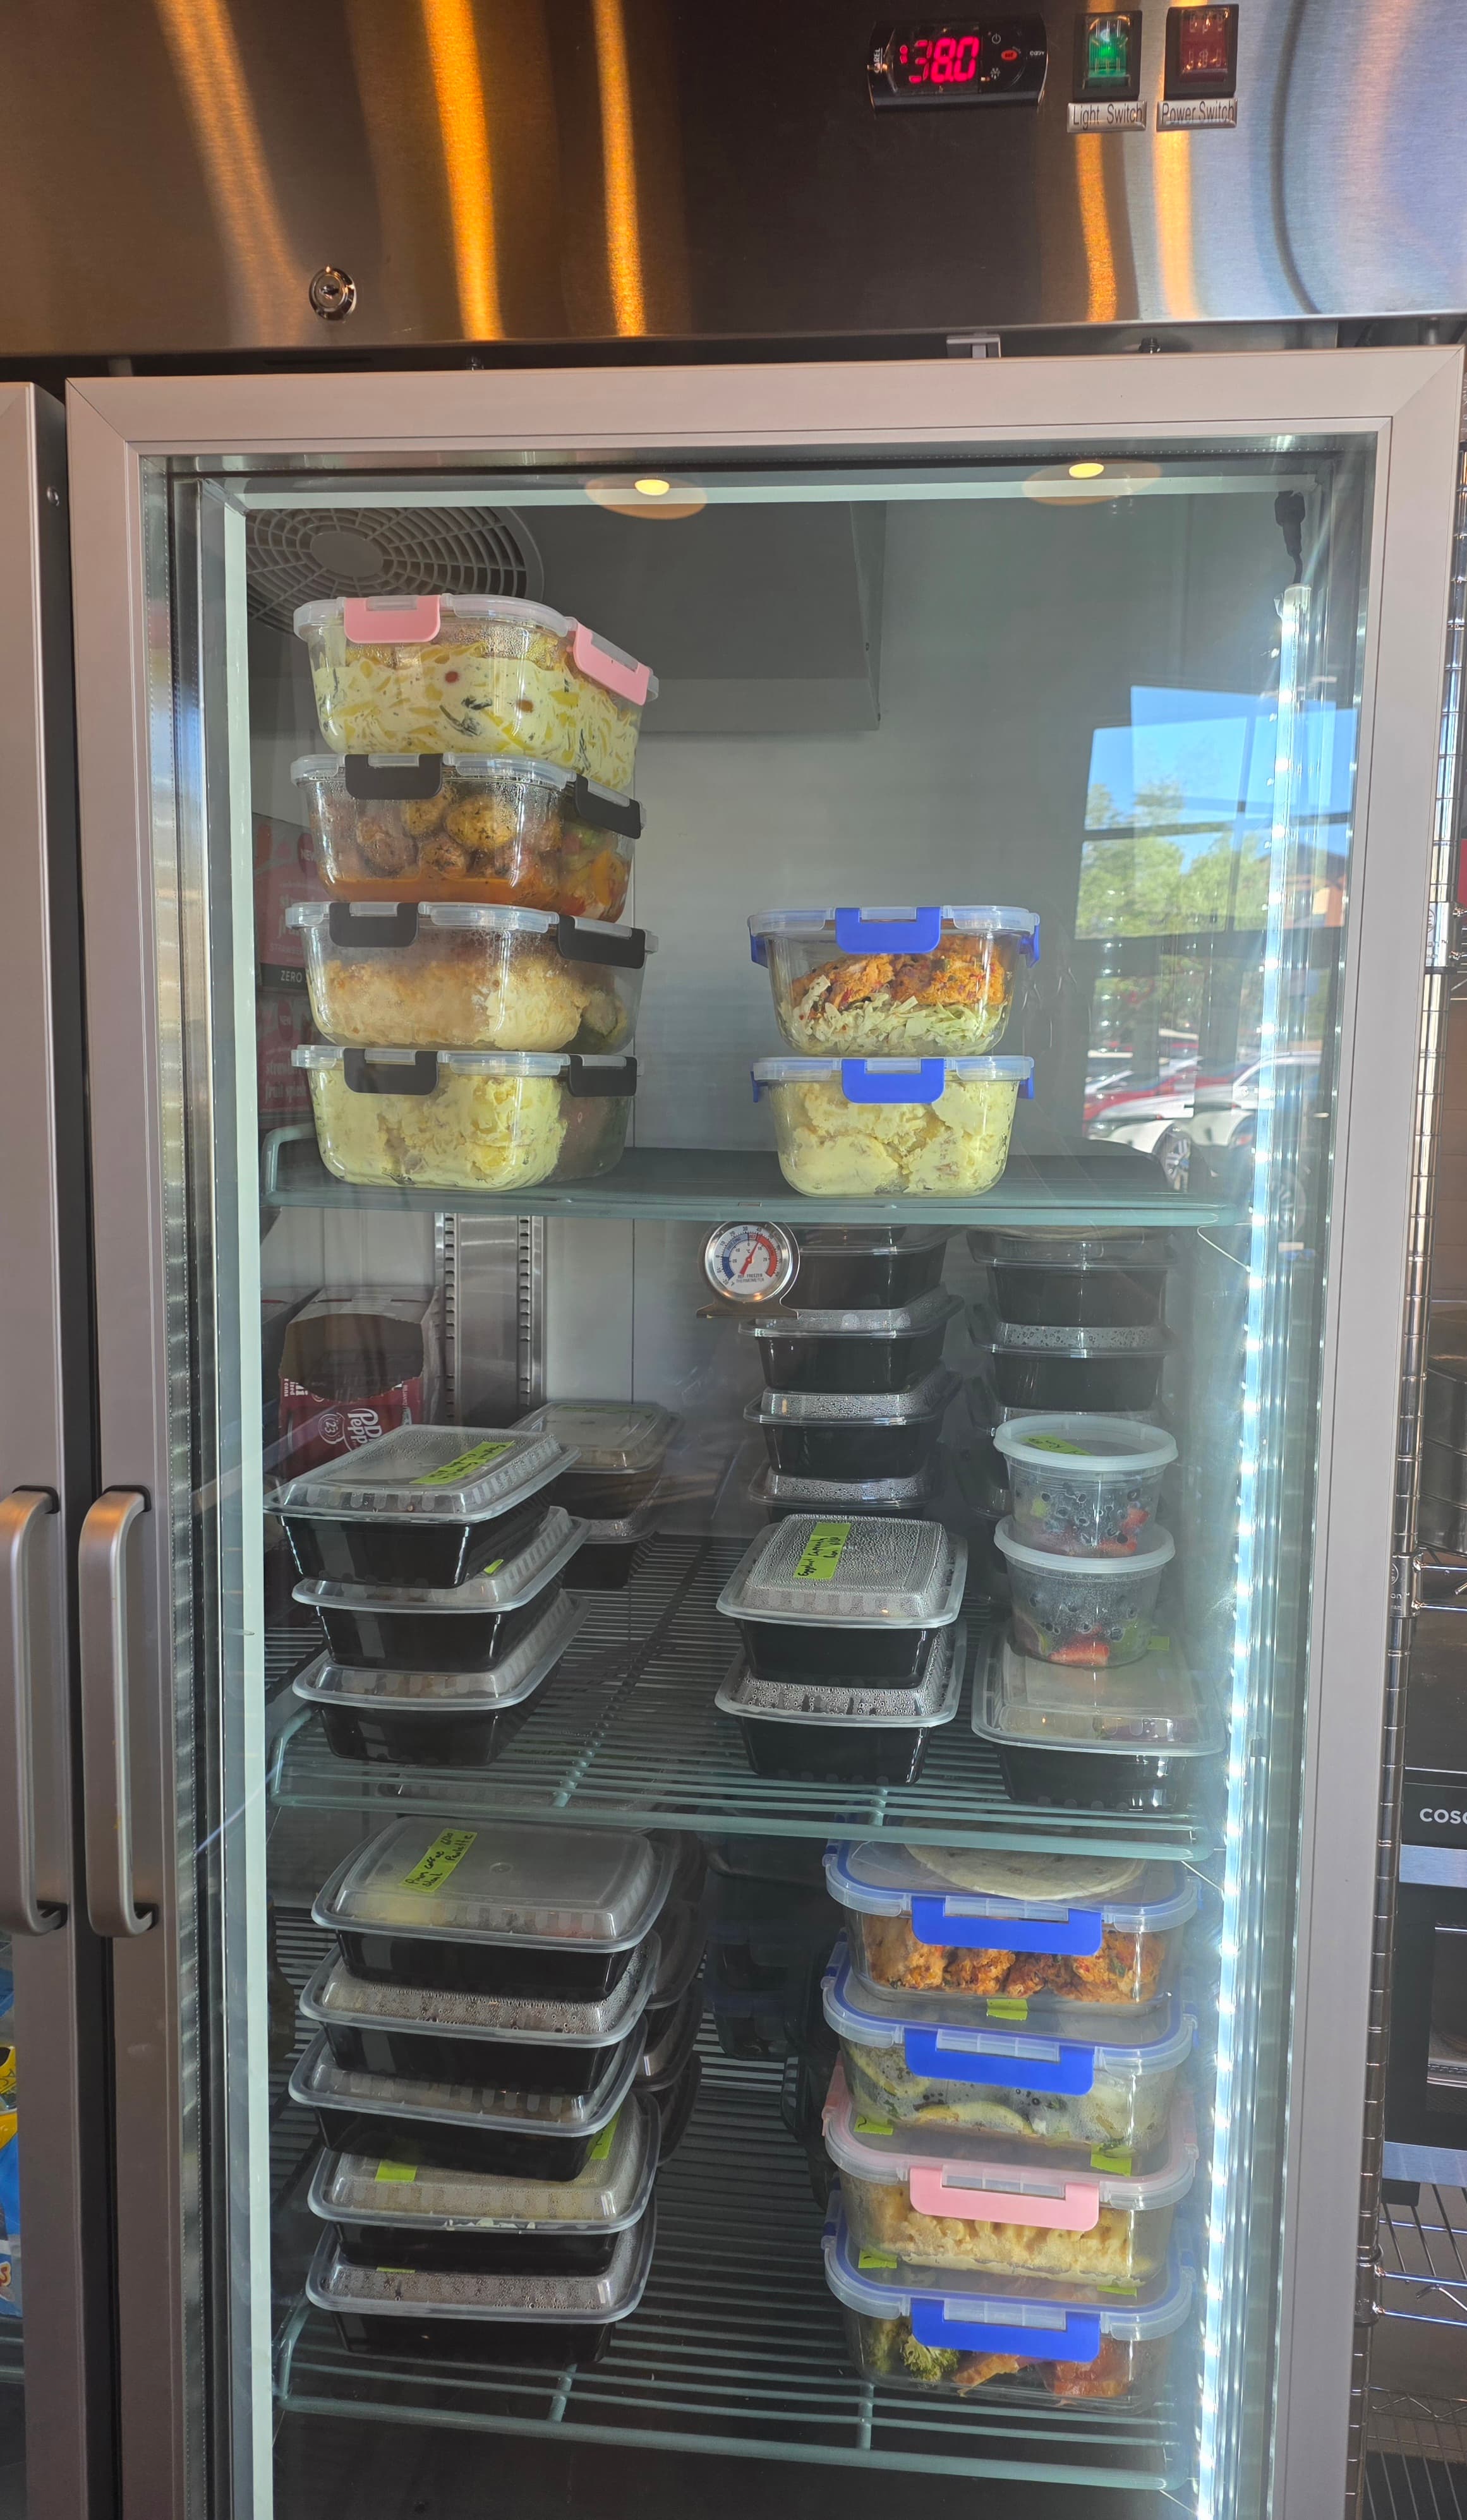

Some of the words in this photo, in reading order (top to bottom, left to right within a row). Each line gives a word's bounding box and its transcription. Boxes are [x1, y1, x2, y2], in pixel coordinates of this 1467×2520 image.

[1073, 104, 1100, 130] Light
[1106, 102, 1143, 124] Switch
[1162, 102, 1196, 124] Power
[1198, 100, 1234, 121] Switch
[281, 971, 302, 983] ZERO
[325, 1420, 337, 1434] 23
